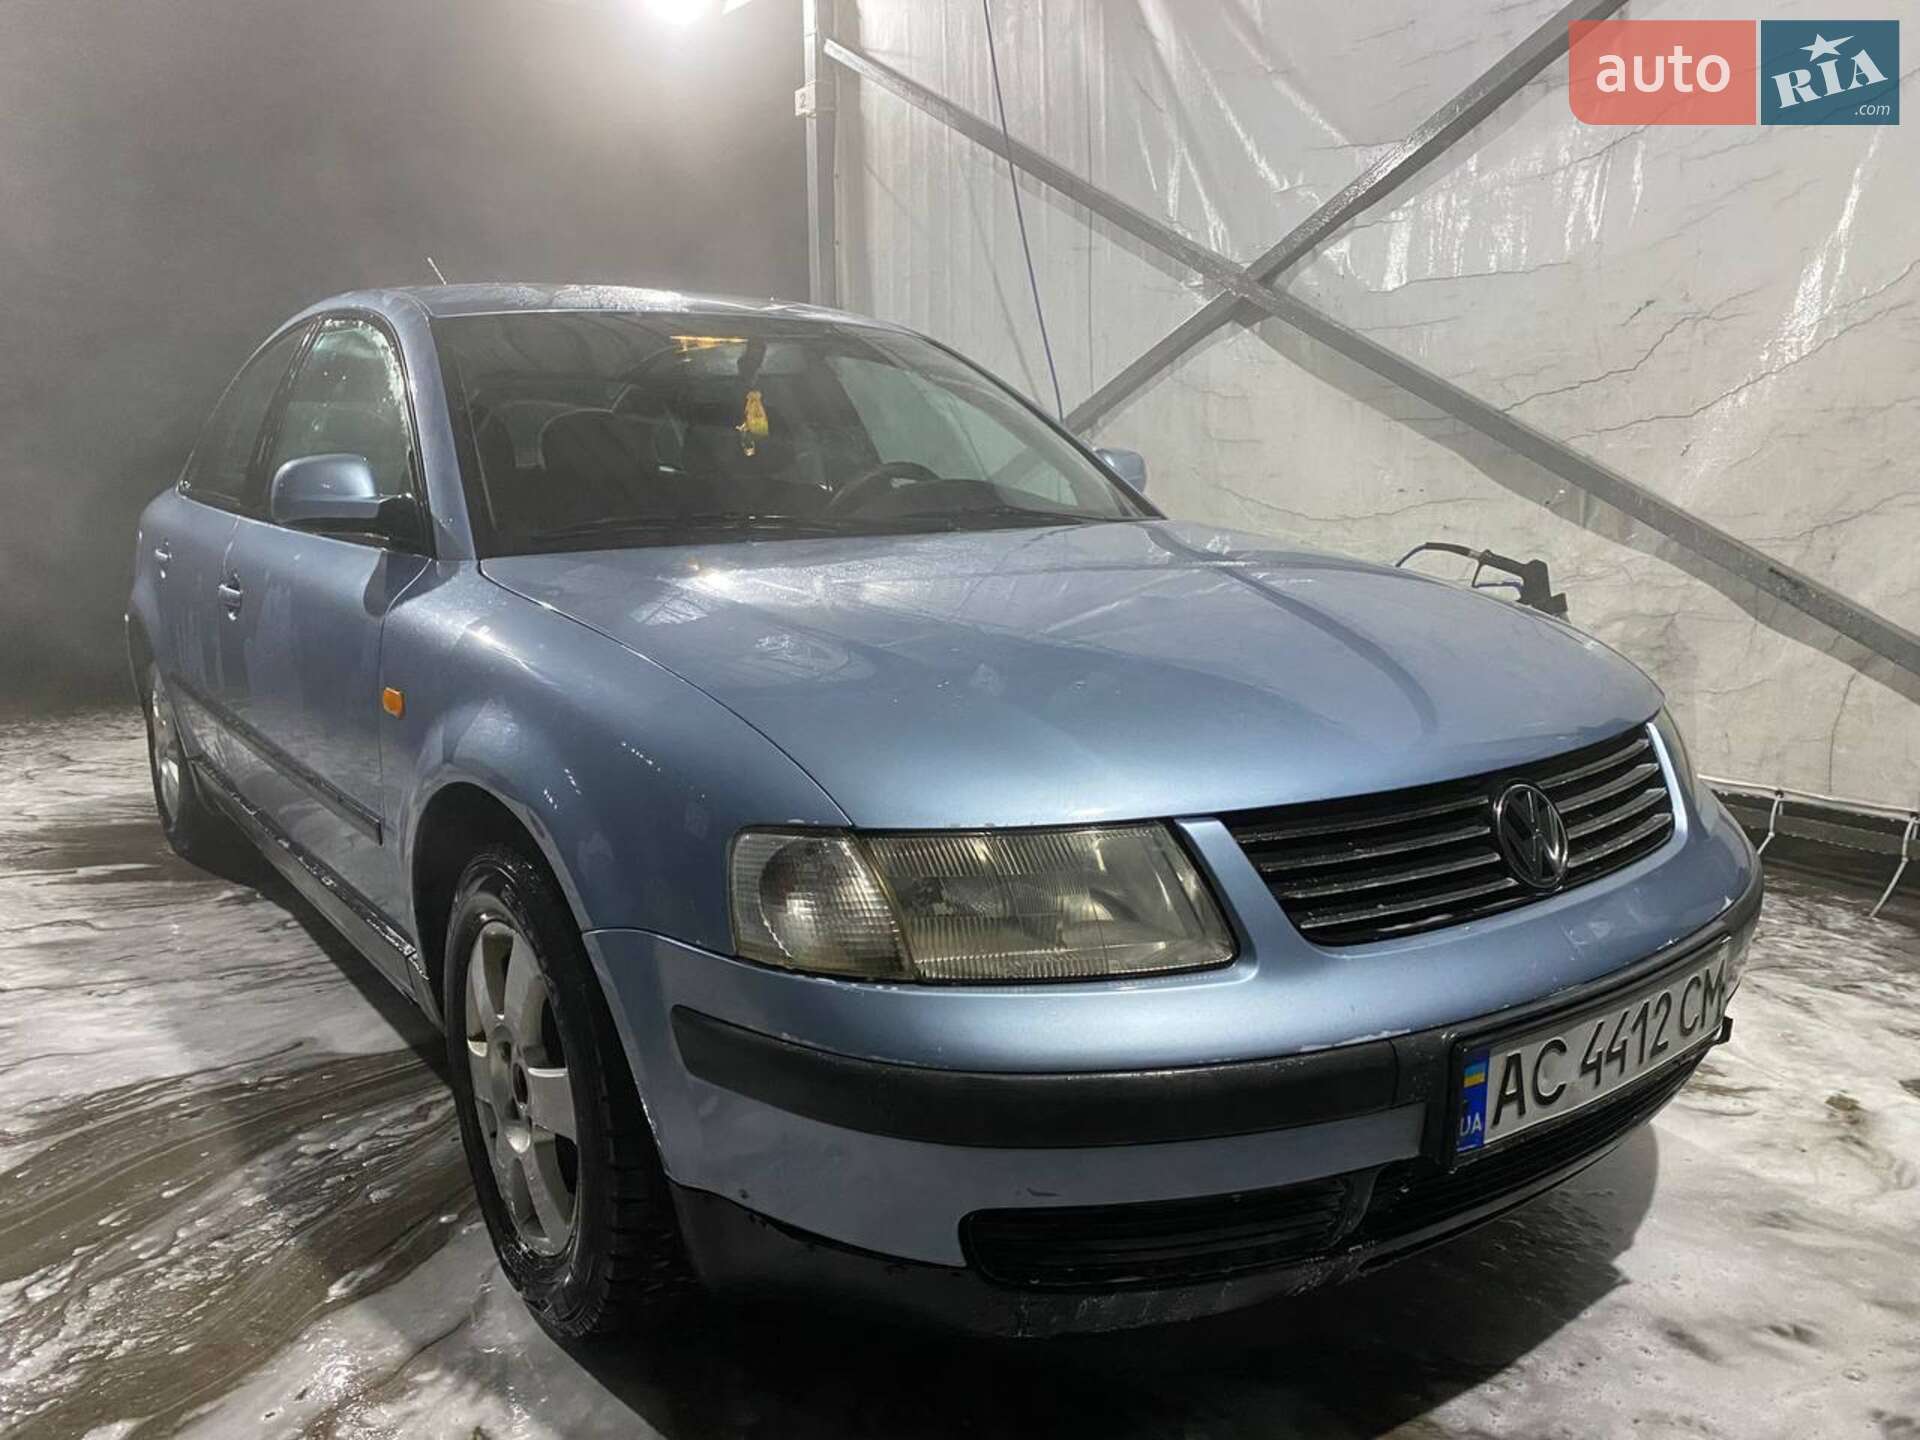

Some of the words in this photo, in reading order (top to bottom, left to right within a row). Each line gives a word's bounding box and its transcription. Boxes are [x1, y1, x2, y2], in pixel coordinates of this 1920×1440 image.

[1491, 1037, 1567, 1129] AC
[1579, 989, 1673, 1087] 4412
[1680, 959, 1727, 1037] CM
[1459, 1111, 1482, 1136] UA
